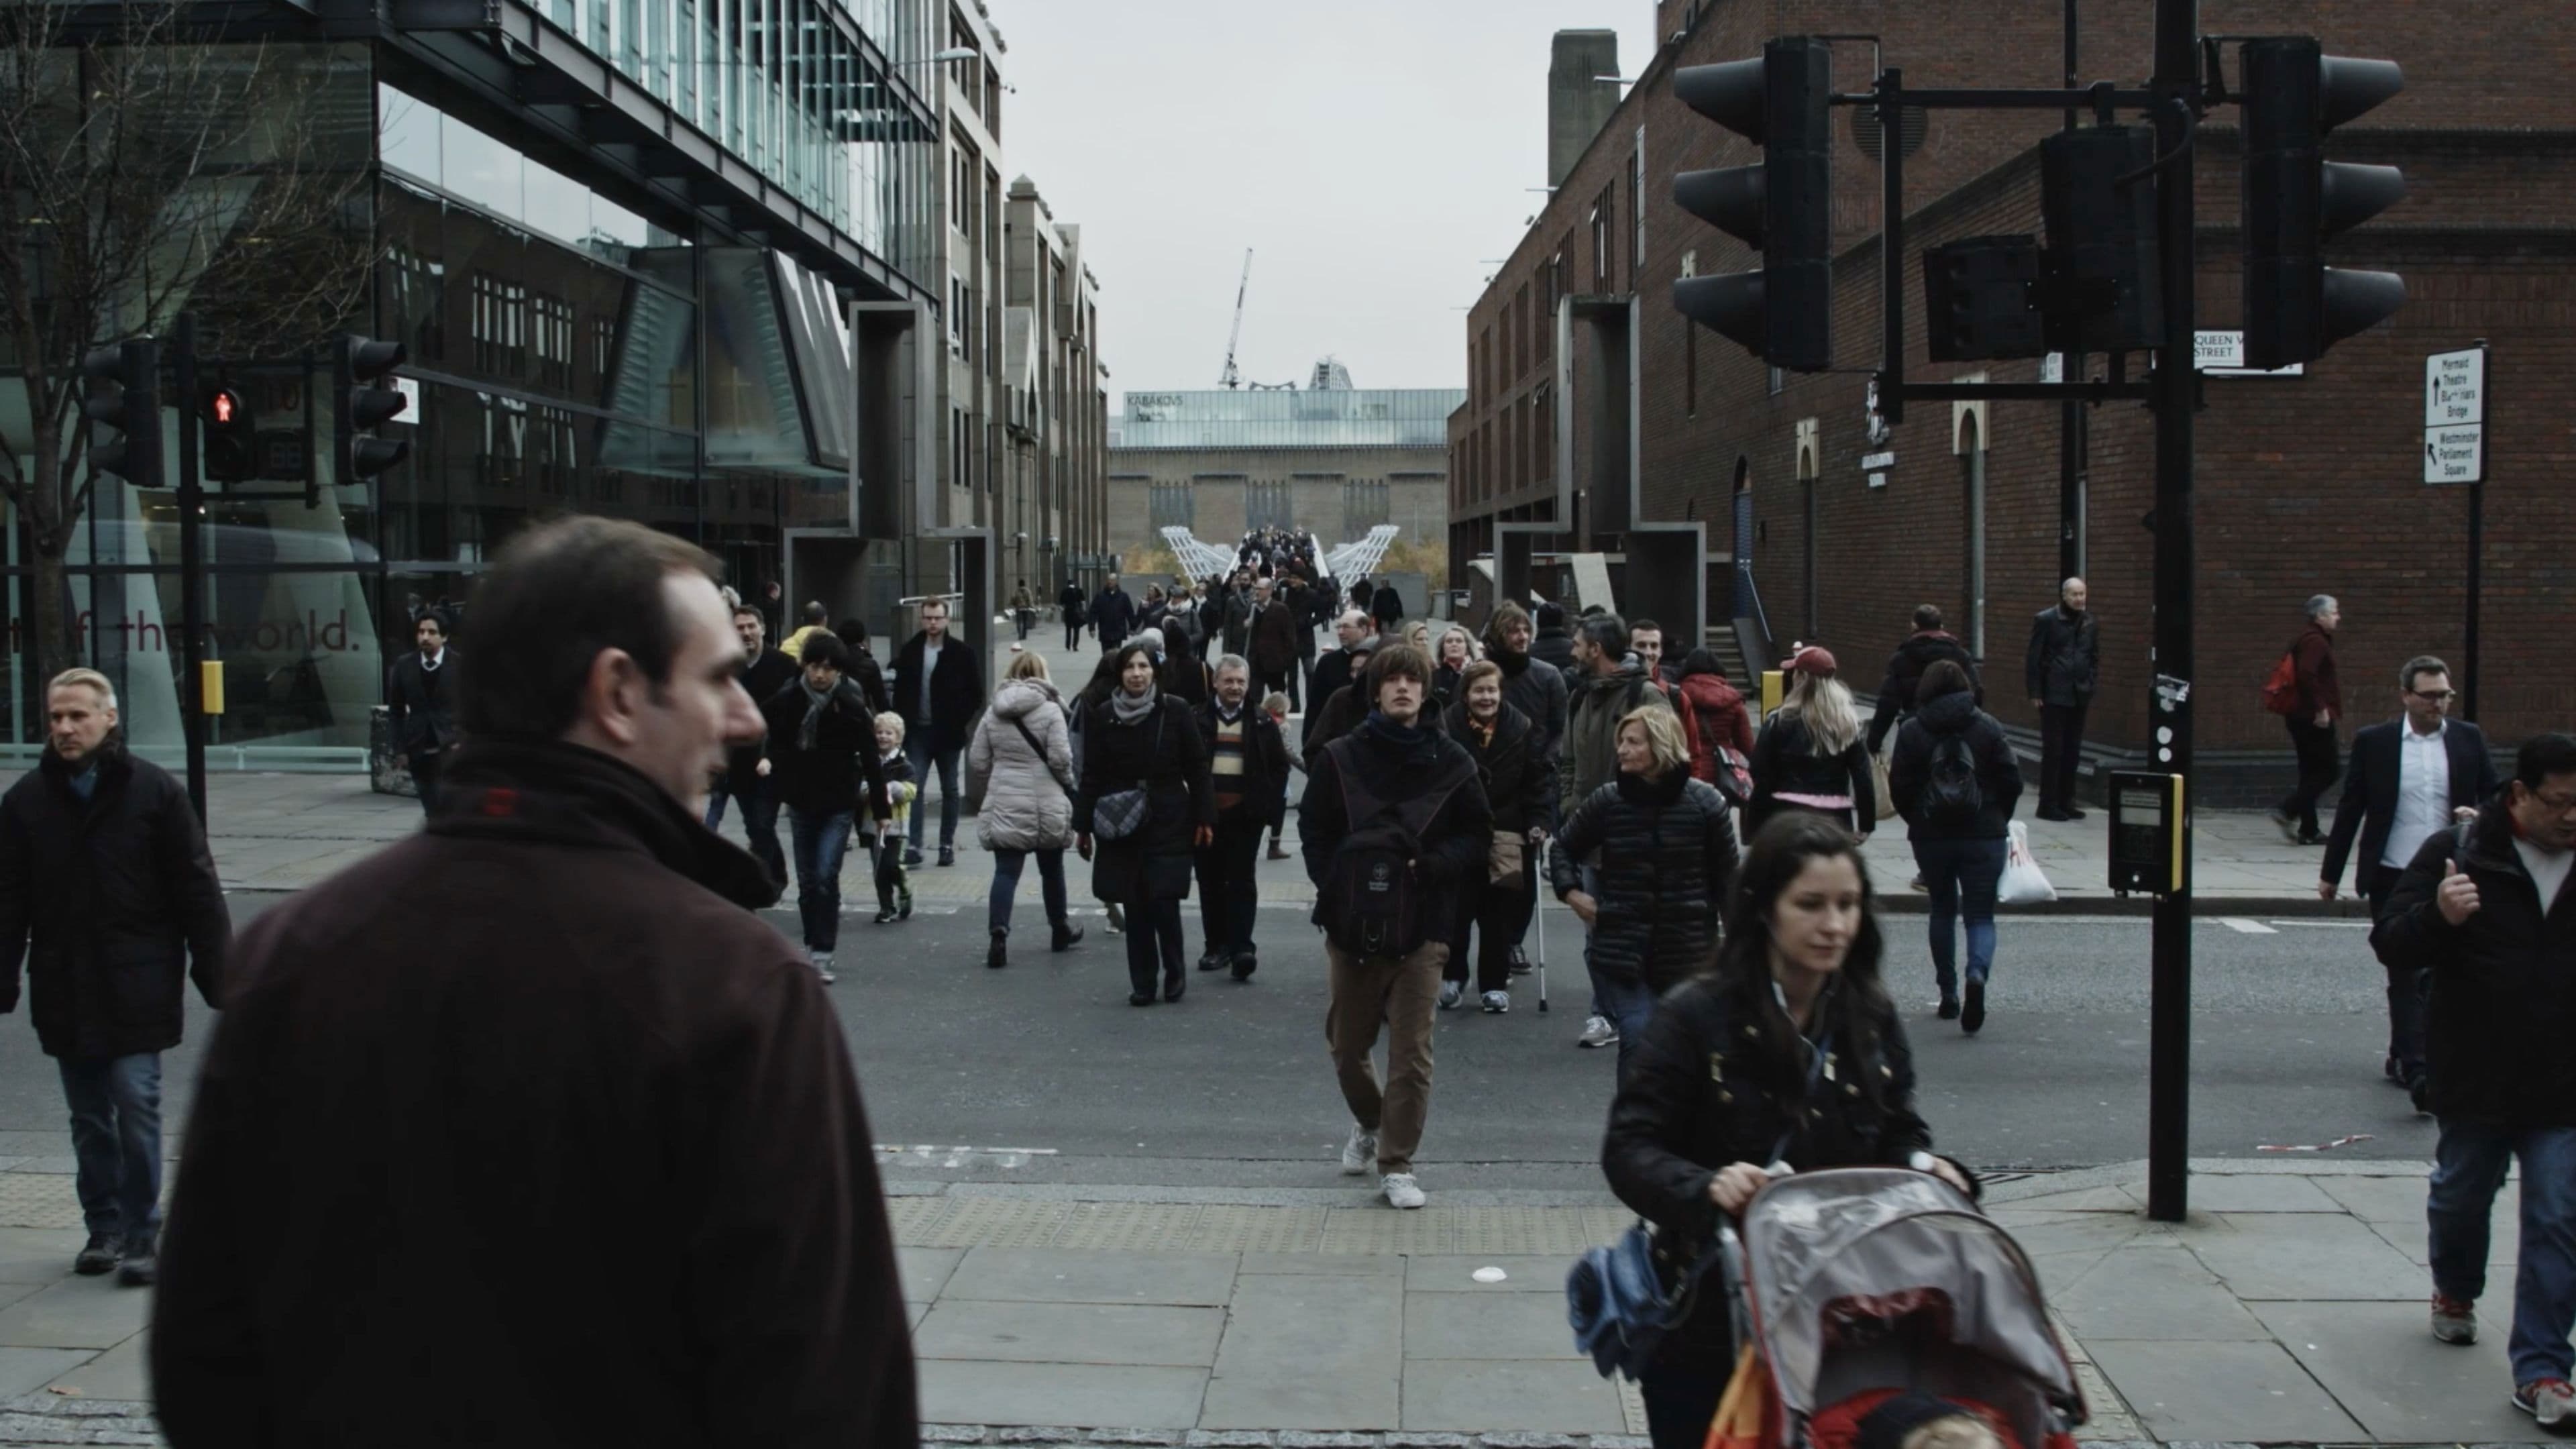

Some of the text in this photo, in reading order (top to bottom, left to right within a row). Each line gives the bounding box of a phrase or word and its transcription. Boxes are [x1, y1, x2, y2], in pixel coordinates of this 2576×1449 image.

[2194, 335, 2233, 345] QUEEN
[2194, 347, 2233, 358] STREET
[2442, 358, 2469, 370] Mermaid
[2443, 374, 2467, 386] Theatre
[2447, 405, 2469, 418] Bridge
[2439, 431, 2479, 444] Westminster
[2439, 448, 2473, 460] Parliament
[2444, 464, 2467, 477] Square
